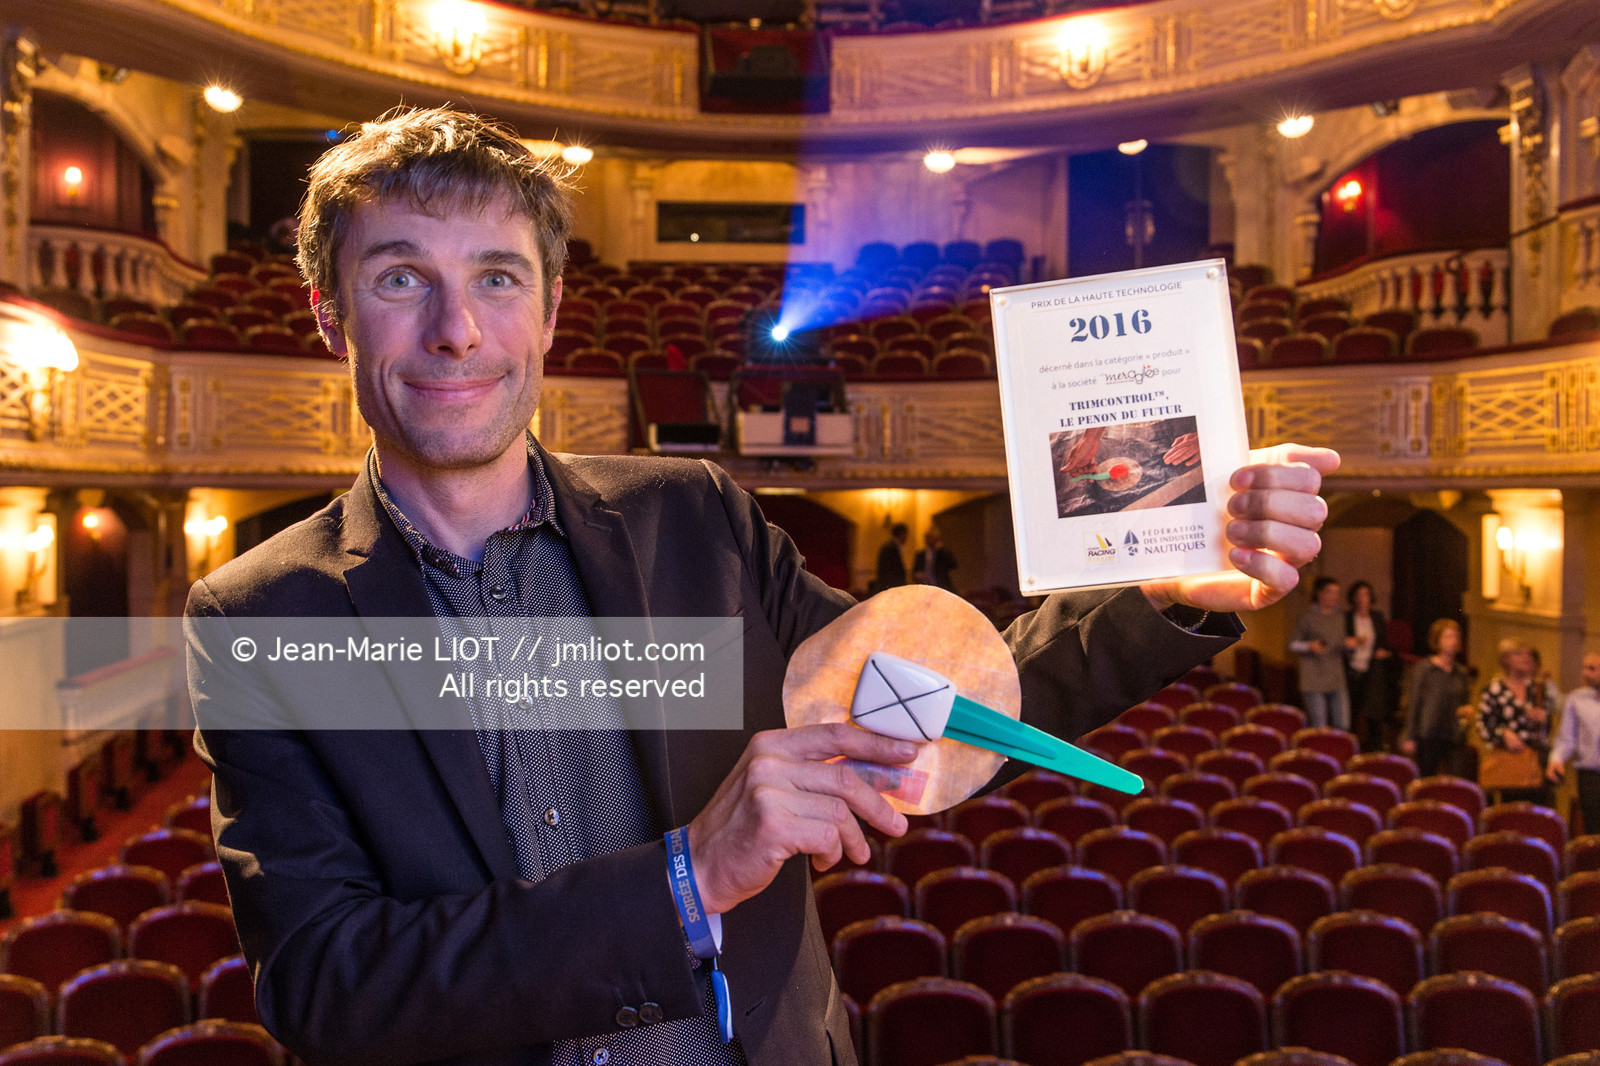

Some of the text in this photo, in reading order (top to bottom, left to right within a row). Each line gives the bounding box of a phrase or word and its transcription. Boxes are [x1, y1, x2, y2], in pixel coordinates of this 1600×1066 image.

[1031, 281, 1182, 309] PRIX DE LA HAUTE TECHNOLOGIE
[1069, 309, 1153, 343] 2016
[1039, 361, 1072, 373] décerné
[1074, 361, 1093, 369] dans
[1095, 358, 1103, 366] la
[1104, 353, 1144, 365] catégorie
[1152, 348, 1183, 360] produit
[1058, 381, 1066, 389] la
[1067, 376, 1097, 388] société
[1162, 367, 1181, 378] pour
[1060, 404, 1183, 428] LE PENON DU FUTUR
[1143, 532, 1205, 545] DES INDUSTRIES
[1145, 540, 1206, 555] NAUTIQUES
[673, 854, 688, 879] DES
[677, 878, 701, 924] SOIRÉE
